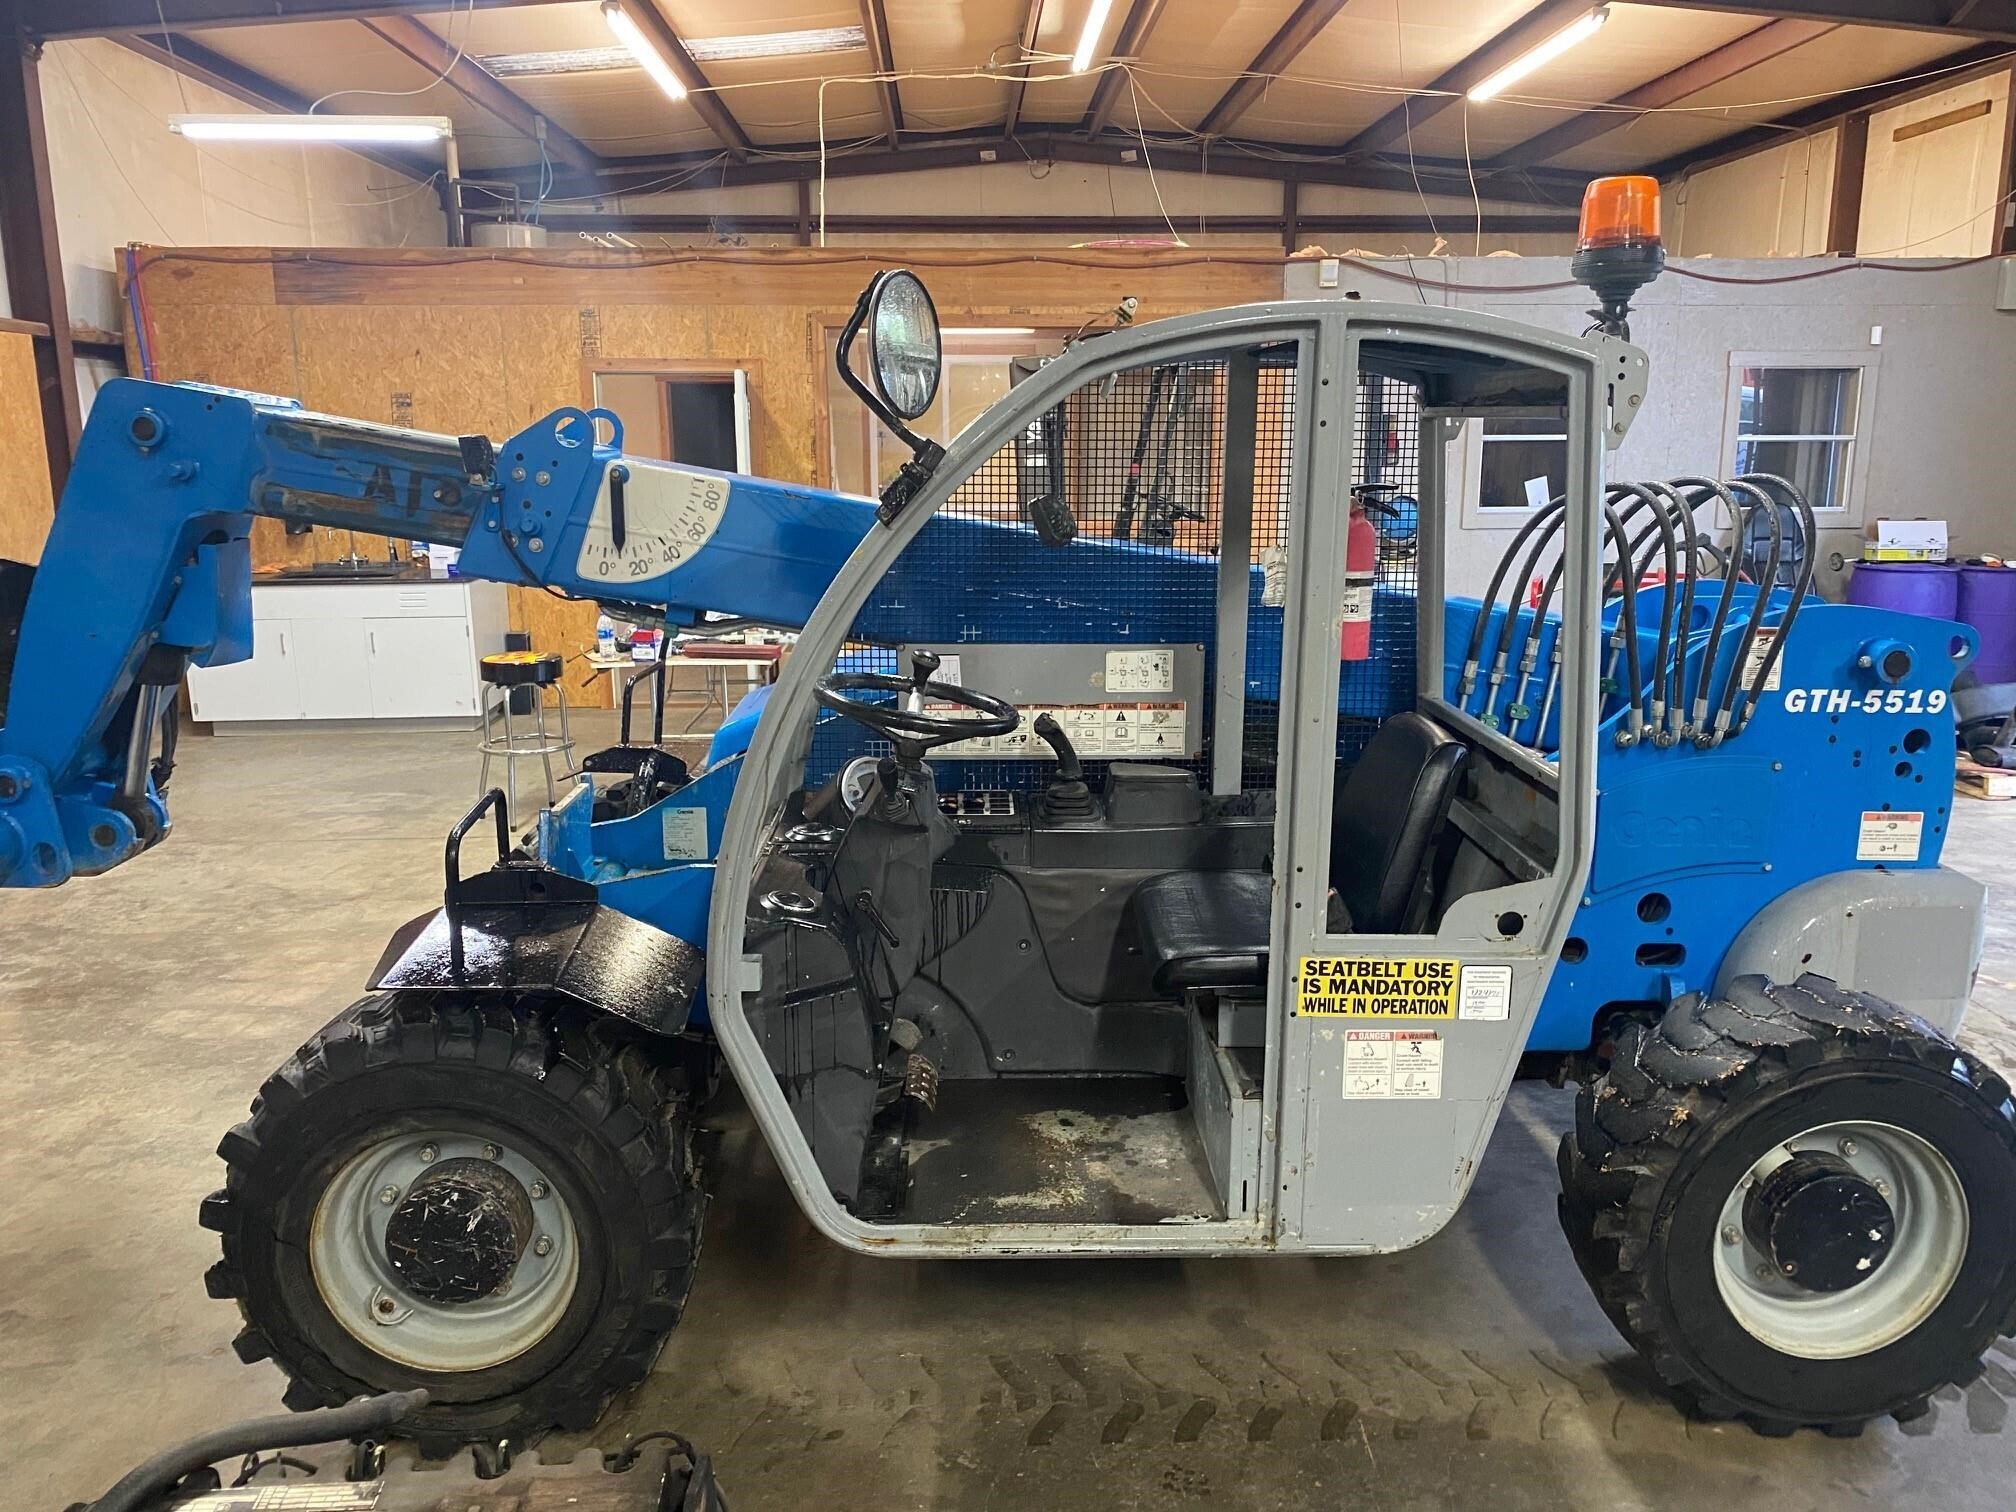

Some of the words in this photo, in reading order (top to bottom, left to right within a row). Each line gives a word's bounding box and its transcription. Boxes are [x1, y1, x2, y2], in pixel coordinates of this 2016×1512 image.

[703, 483, 721, 511] 80°
[687, 516, 707, 542] 60°
[663, 541, 683, 563] 40°
[599, 561, 616, 576] 0°
[629, 558, 654, 576] 20°
[1784, 688, 1947, 714] GTH-5519
[1305, 960, 1407, 978] SEATBELT
[1414, 962, 1454, 979] USE
[1302, 978, 1321, 994] IS
[1328, 978, 1454, 996] MANDATORY
[1304, 997, 1348, 1014] WHILE
[1352, 998, 1367, 1014] IN
[1371, 998, 1449, 1015] OPERATION
[1358, 1032, 1391, 1041] DANGER
